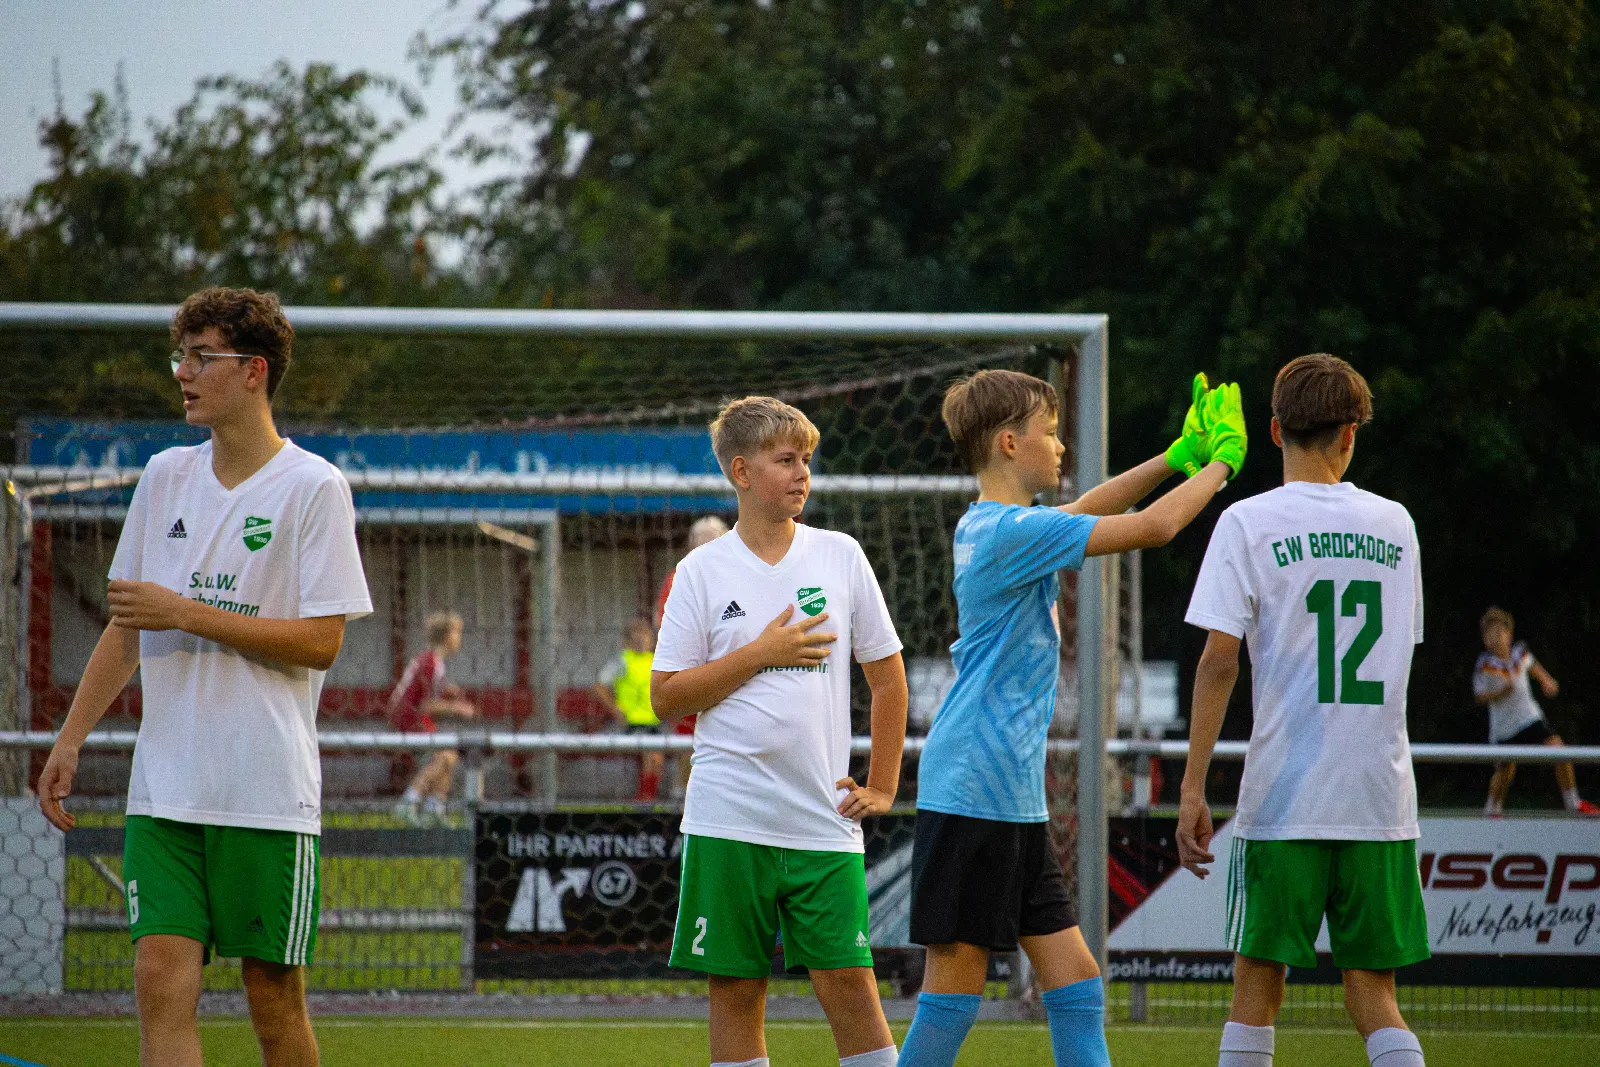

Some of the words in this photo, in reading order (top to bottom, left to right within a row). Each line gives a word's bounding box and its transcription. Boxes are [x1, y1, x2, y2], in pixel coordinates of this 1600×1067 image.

[248, 518, 259, 526] GW
[1271, 535, 1304, 568] GW
[1308, 532, 1403, 570] BROCKDORF
[721, 610, 746, 620] adidas
[1305, 579, 1385, 705] 12
[507, 833, 551, 858] IHR
[554, 833, 668, 858] PARTNER
[598, 871, 630, 896] 67
[127, 879, 140, 925] 6
[691, 916, 708, 956] 2
[1436, 900, 1600, 946] Nutzfahrzeug
[1107, 957, 1237, 980] pohl-nfz-serv
